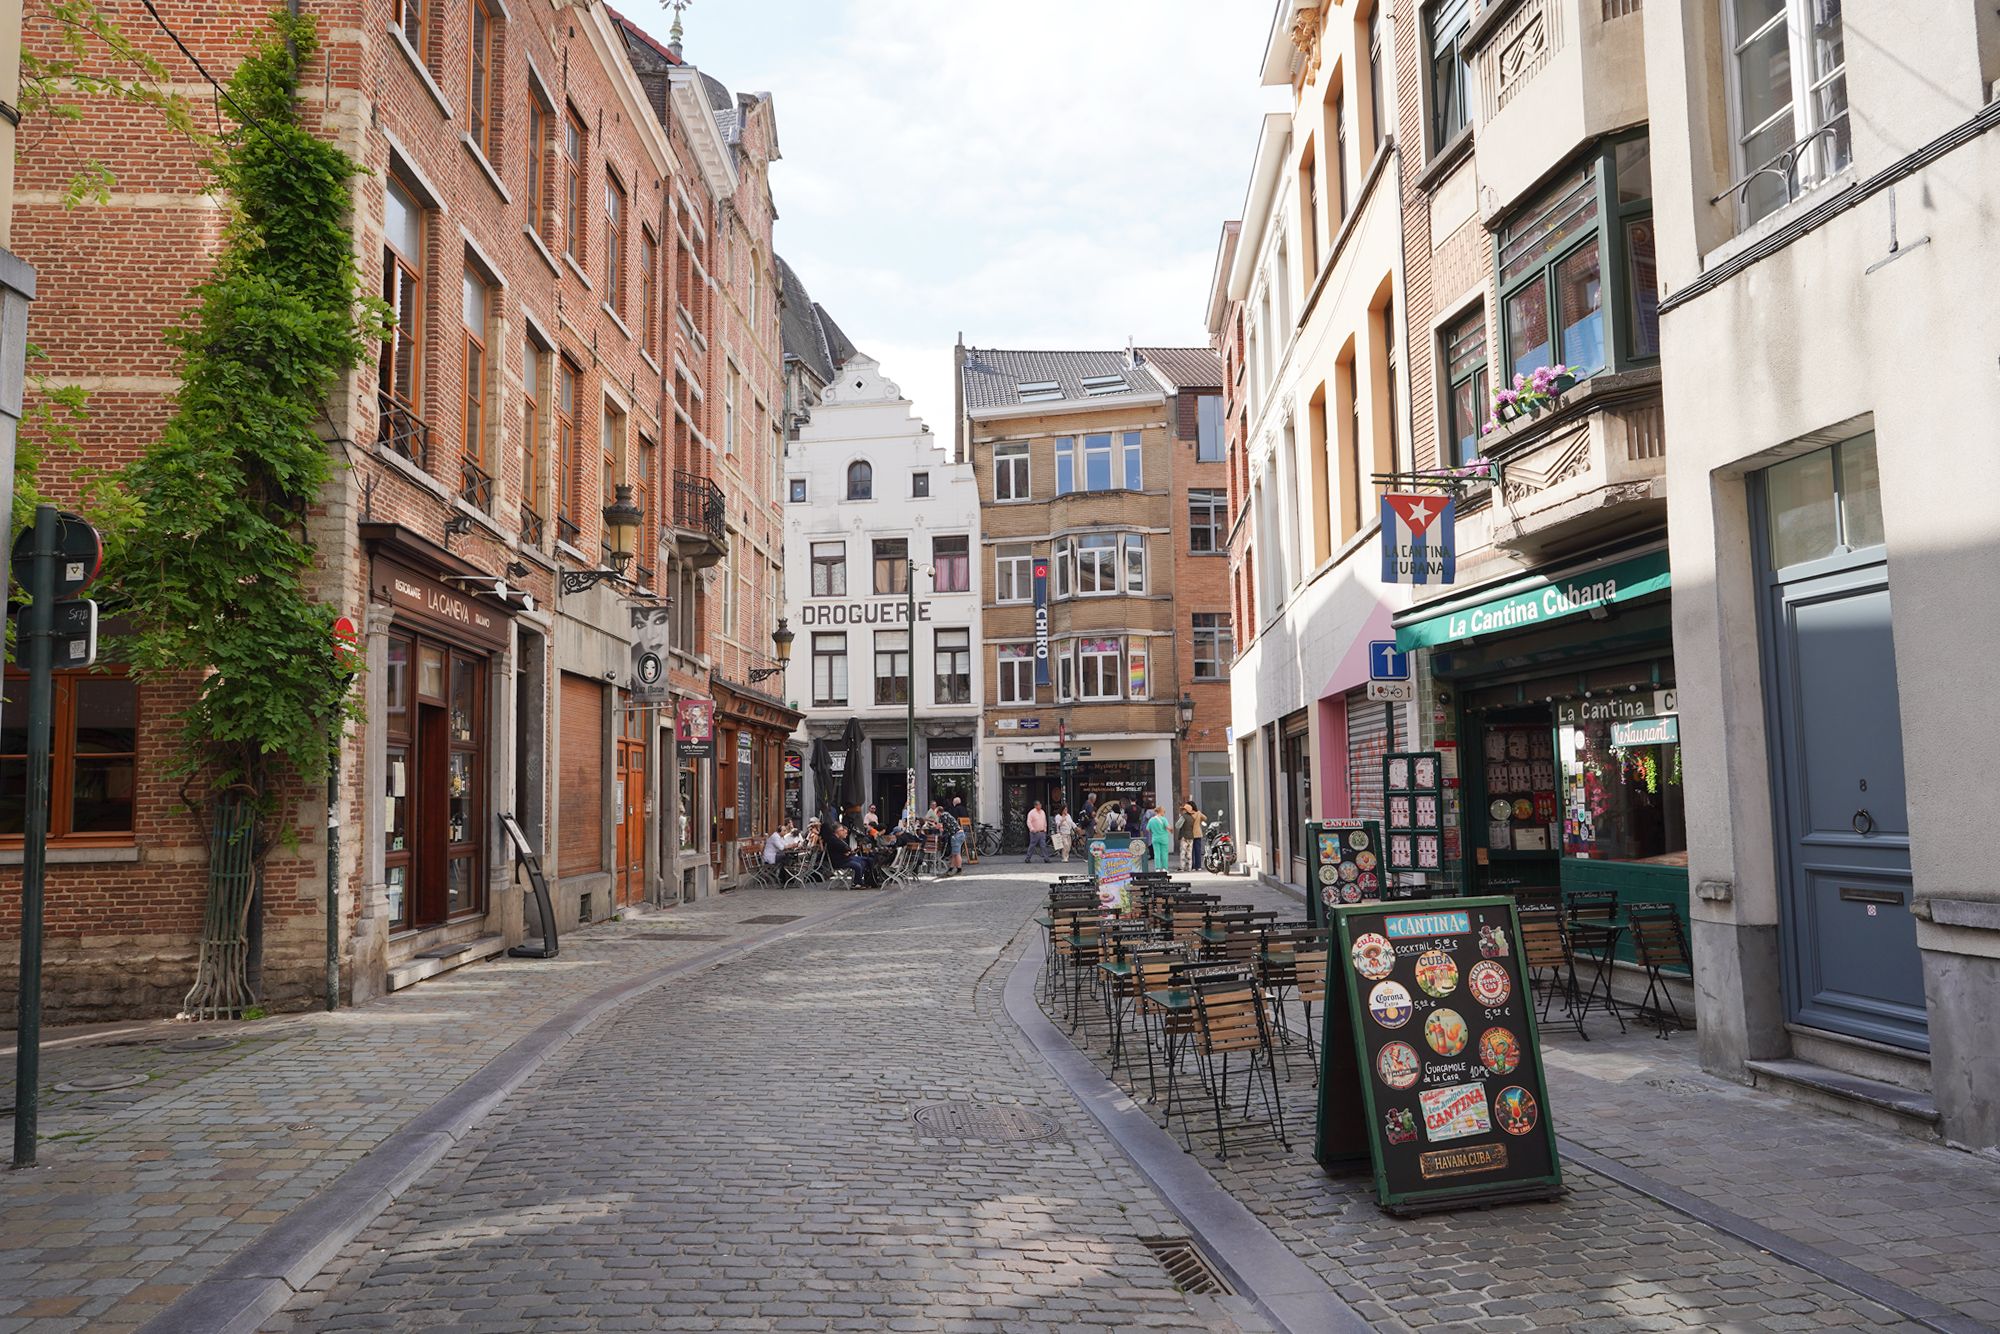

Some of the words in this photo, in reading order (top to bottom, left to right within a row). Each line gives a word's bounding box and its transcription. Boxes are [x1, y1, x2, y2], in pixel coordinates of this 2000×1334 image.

[1402, 545, 1450, 558] CANTINA
[395, 579, 421, 600] RISTORANTE
[428, 588, 439, 612] LA
[439, 594, 470, 624] CANEVA
[1449, 615, 1465, 638] La
[1471, 601, 1538, 632] Cantina
[1542, 579, 1617, 616] Cubana
[802, 602, 931, 625] DROGUERIE
[1036, 608, 1048, 659] CHIRO
[1559, 705, 1574, 722] La
[1581, 700, 1644, 720] Cantina
[932, 756, 970, 768] MODERNE
[1860, 778, 1867, 792] 8
[1398, 915, 1460, 935] CANTINA
[1395, 942, 1432, 954] COCKTAIL
[1420, 955, 1452, 966] CUBA
[1472, 963, 1492, 980] HAVANA
[1376, 993, 1404, 1003] Corona
[1426, 1088, 1484, 1130] CANTINA
[1428, 1104, 1441, 1114] Los
[1435, 1153, 1467, 1169] HAVANA
[1469, 1151, 1491, 1164] CUBA
